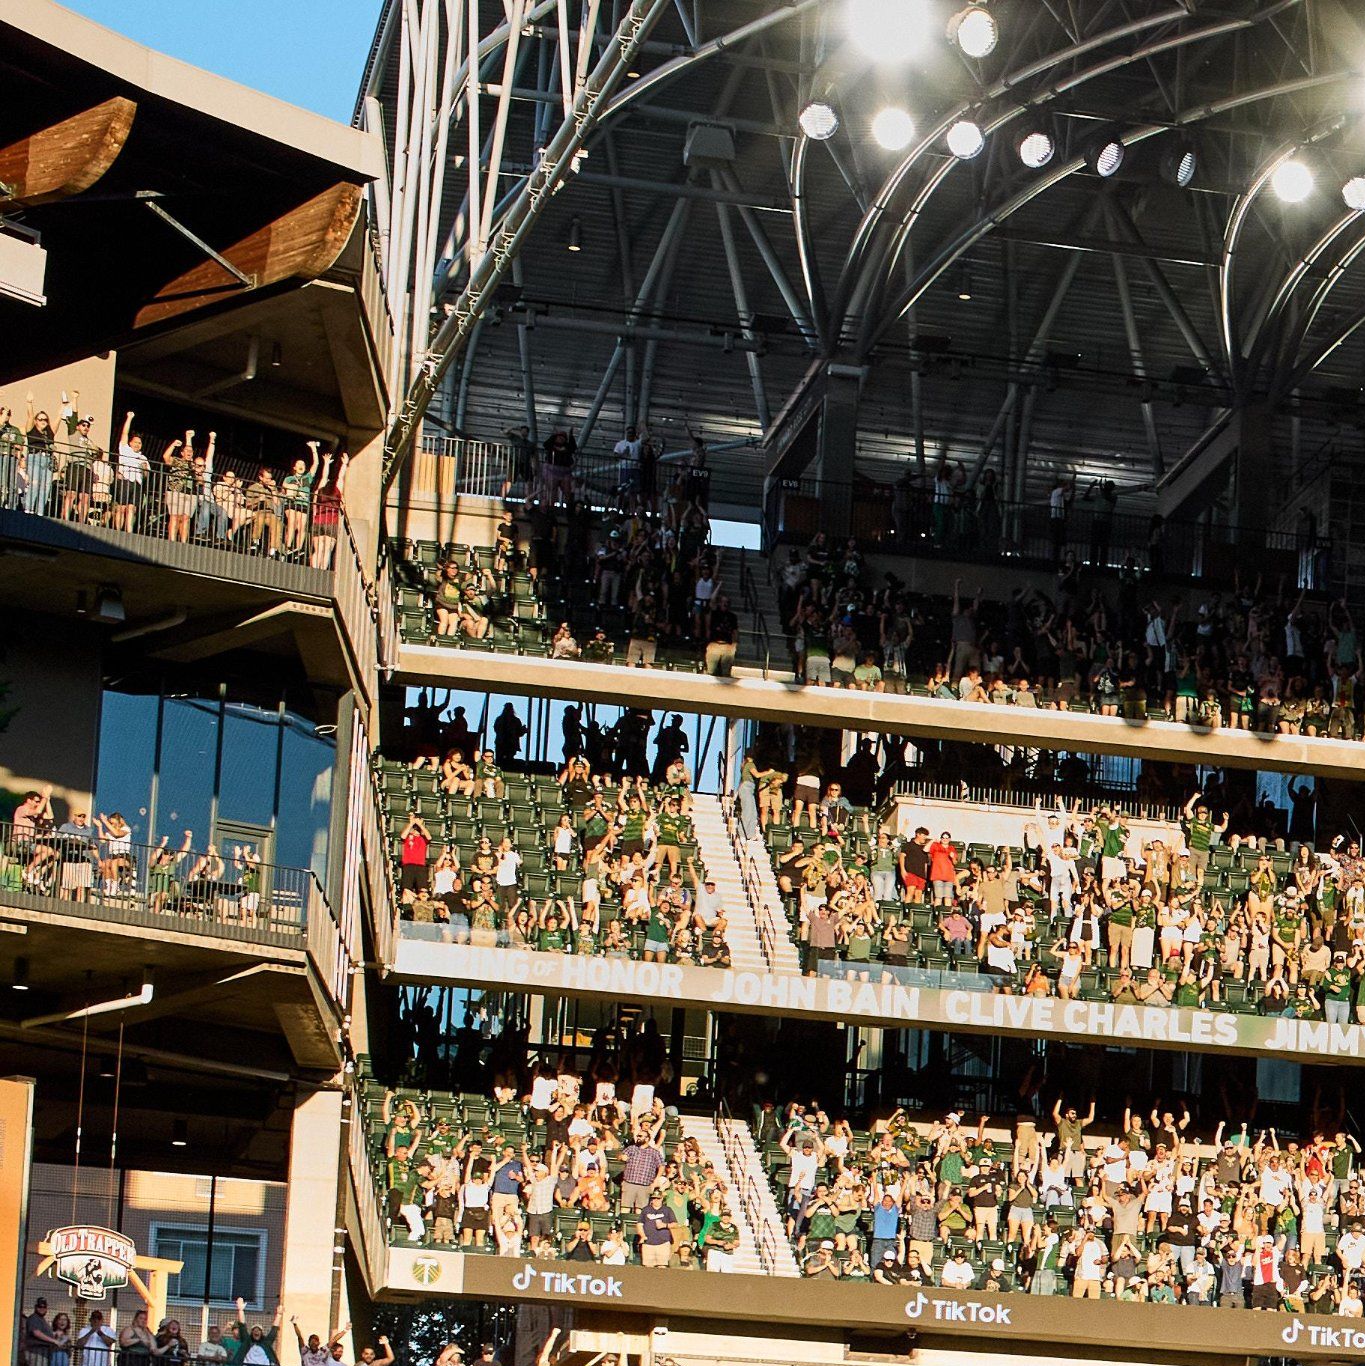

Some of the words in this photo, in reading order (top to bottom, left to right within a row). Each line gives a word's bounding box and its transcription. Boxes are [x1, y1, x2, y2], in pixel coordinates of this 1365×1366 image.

[563, 954, 684, 997] HONOR
[710, 971, 817, 1010] JOHN
[828, 981, 919, 1020] BAIN
[946, 988, 1055, 1028] CLIVE
[1064, 1000, 1237, 1046] CHARLES
[541, 1271, 623, 1297] TikTok
[932, 1300, 1012, 1325] TikTok
